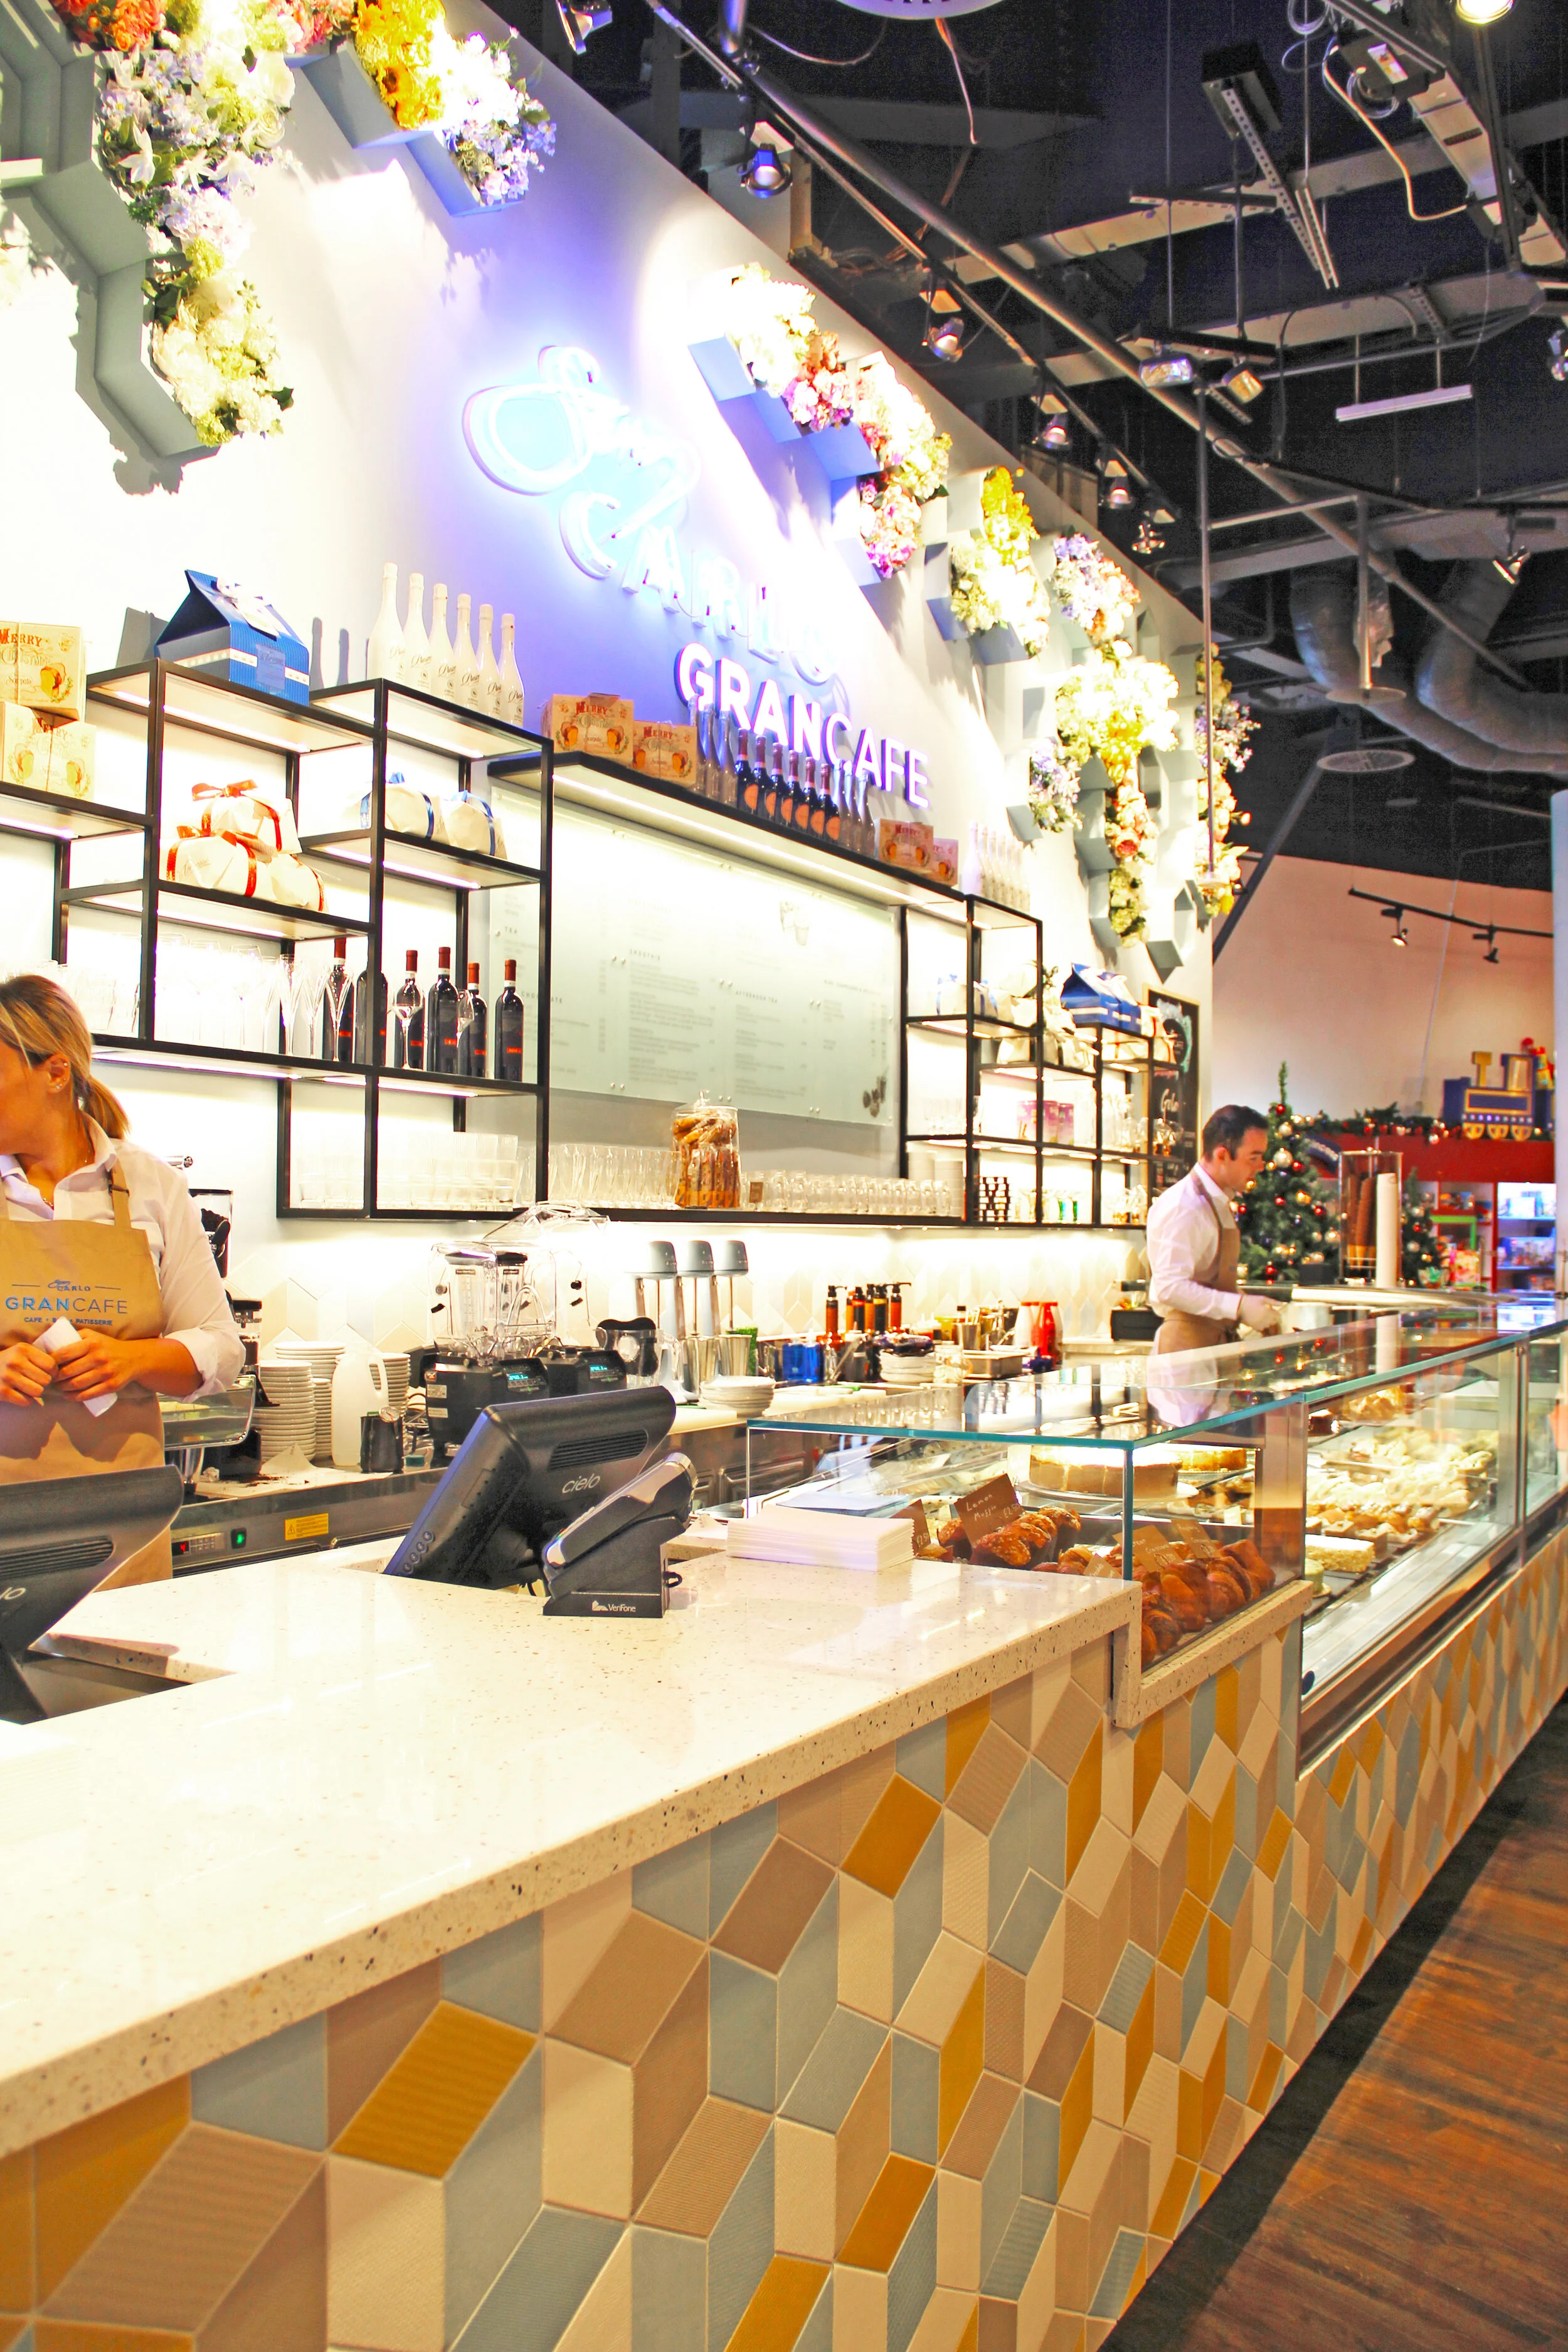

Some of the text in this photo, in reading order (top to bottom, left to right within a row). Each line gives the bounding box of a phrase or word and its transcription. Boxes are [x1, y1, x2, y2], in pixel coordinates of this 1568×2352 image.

[576, 701, 608, 716] MERRY
[643, 726, 674, 739] MERRY
[75, 1318, 113, 1326] PATISSERIE
[562, 1473, 600, 1493] cielo
[966, 1493, 993, 1512] Lemon
[974, 1505, 997, 1522] Muffin
[608, 1603, 637, 1613] VeriFone
